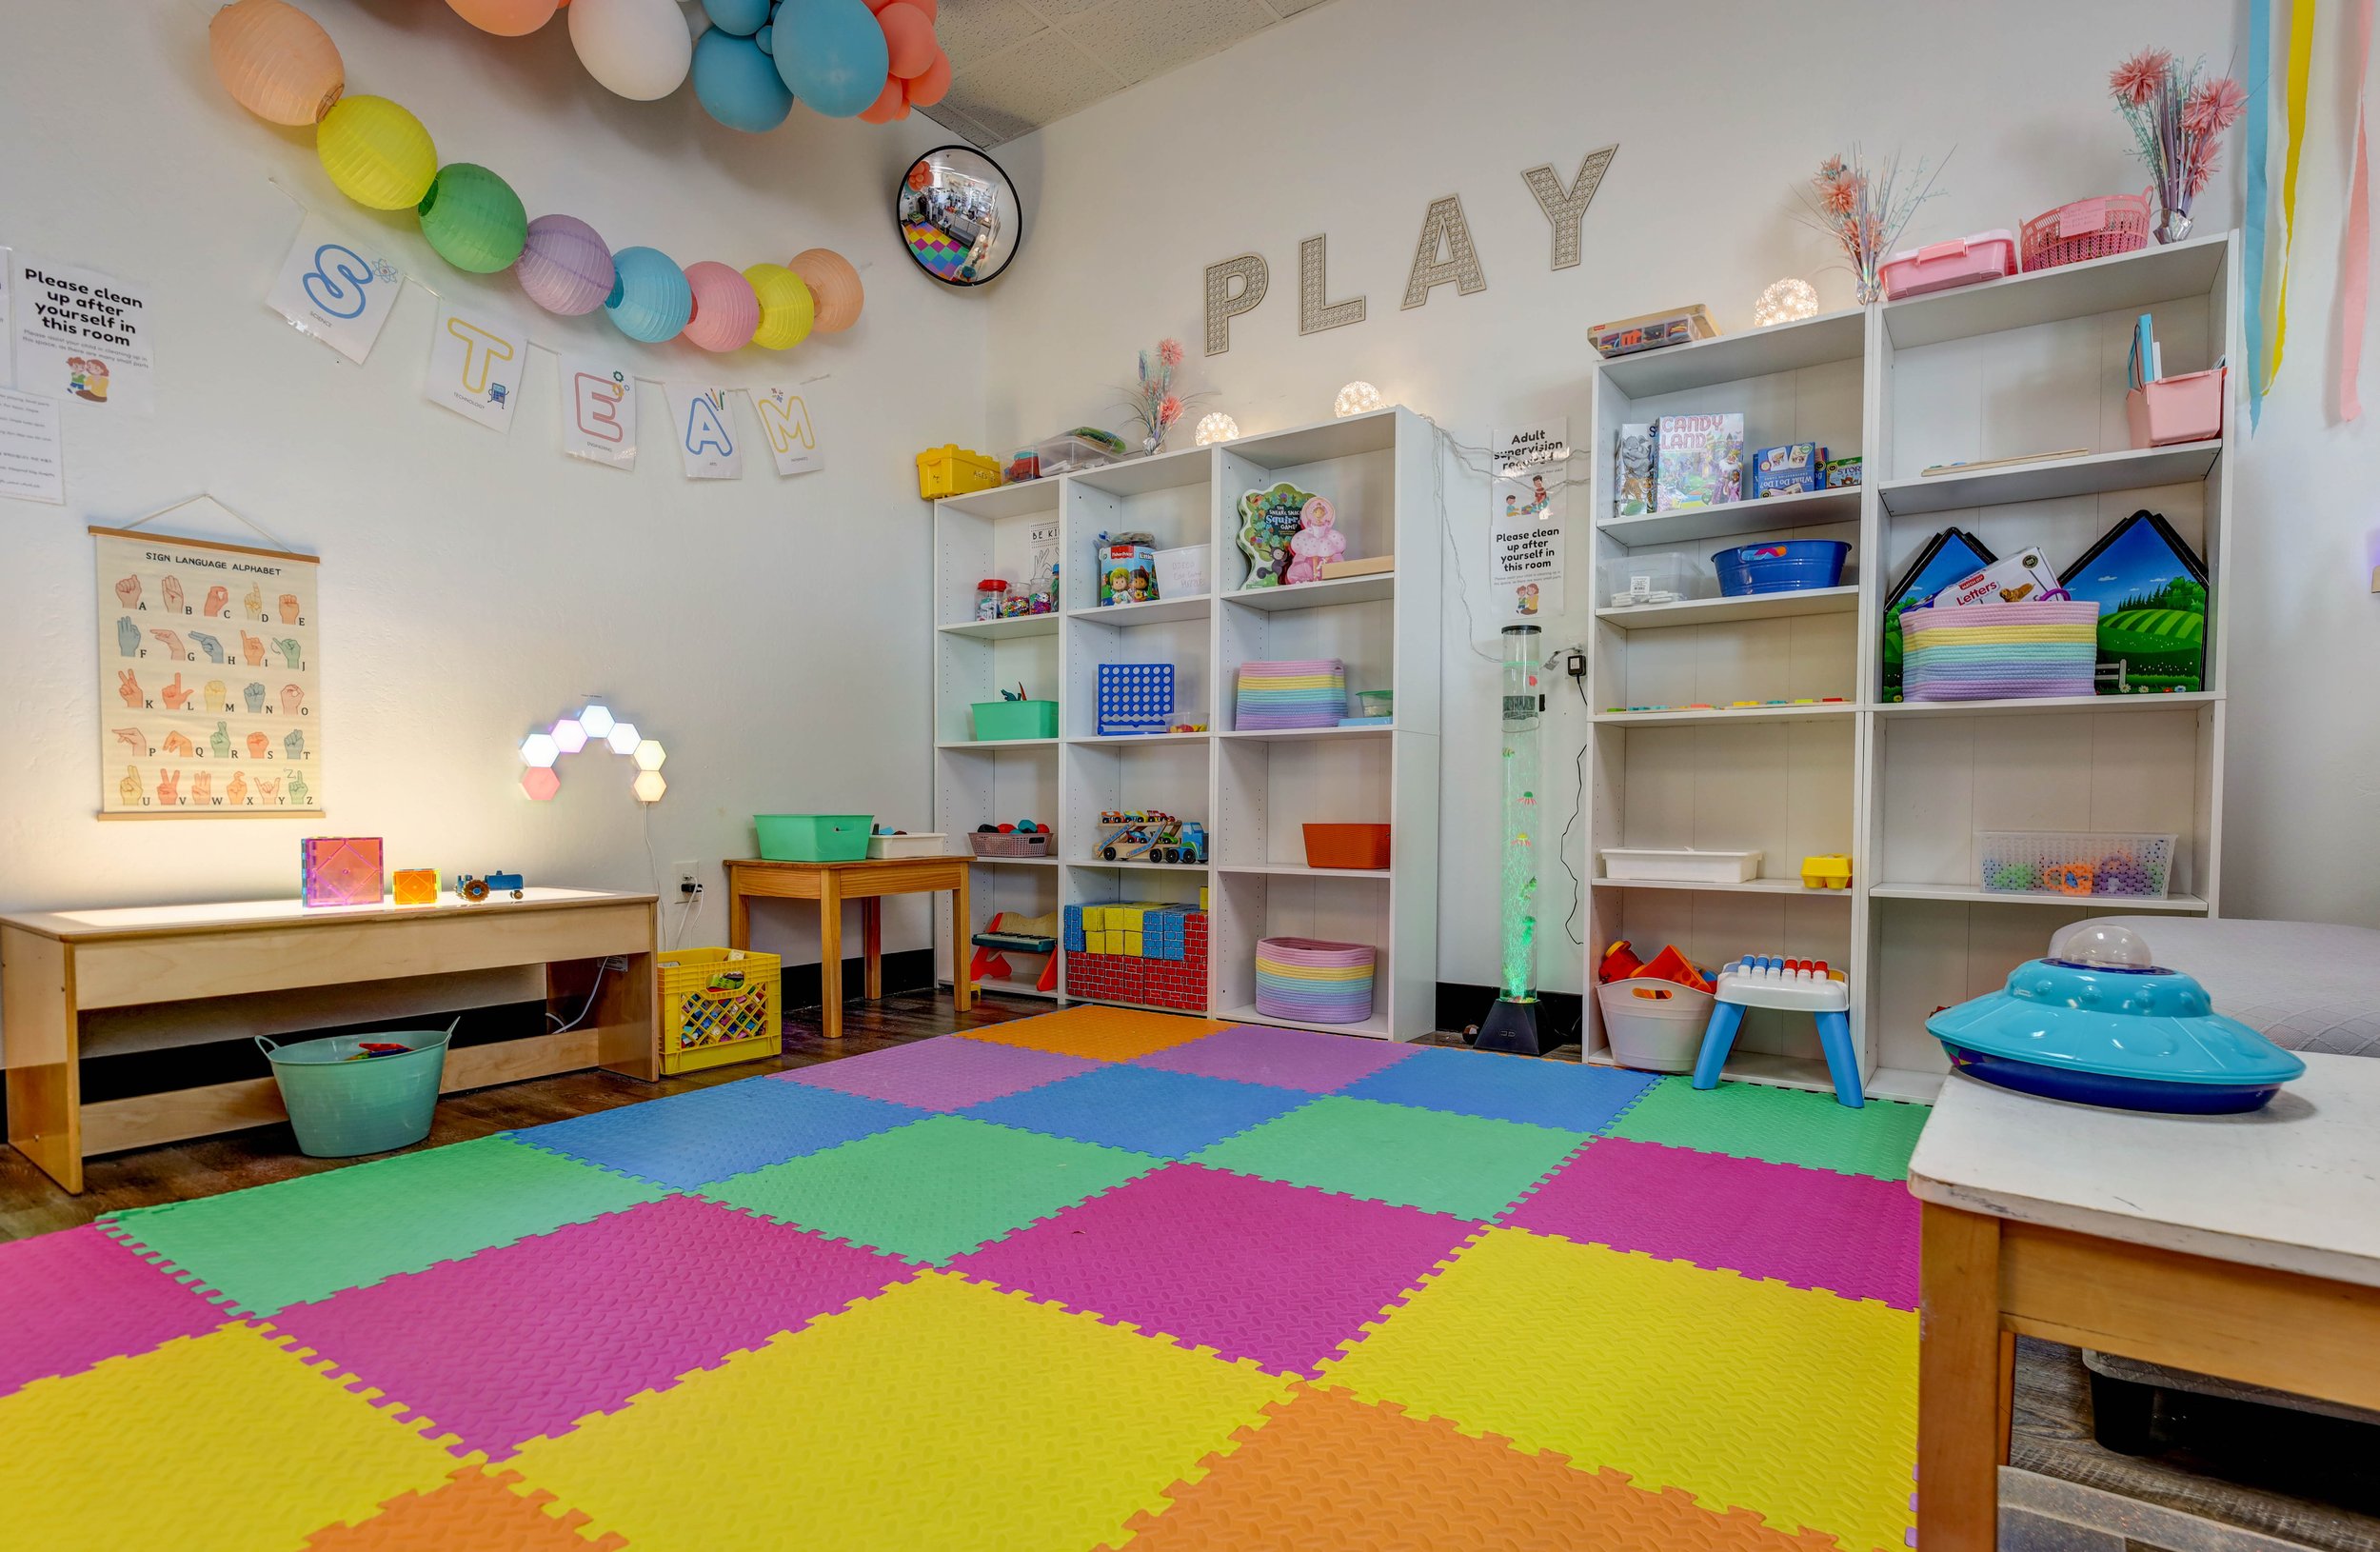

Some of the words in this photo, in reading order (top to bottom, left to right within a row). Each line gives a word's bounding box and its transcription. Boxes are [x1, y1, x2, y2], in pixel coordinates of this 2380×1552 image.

[1203, 143, 1619, 357] PLAY
[25, 268, 89, 294] Please
[94, 288, 143, 308] clean
[302, 243, 374, 319] S
[48, 291, 69, 306] up
[76, 298, 124, 316] after
[34, 302, 115, 328] yourself
[120, 320, 136, 333] in
[42, 316, 77, 334] this
[83, 328, 129, 347] room
[446, 316, 514, 394] T
[574, 371, 624, 443] E
[685, 397, 733, 457] A
[758, 395, 816, 453] M
[1661, 414, 1724, 433] CANDY
[1511, 429, 1545, 445] Adult
[1660, 432, 1707, 450] LAND
[1791, 475, 1814, 487] What
[1048, 528, 1060, 538] KI
[1496, 532, 1529, 543] Please
[1532, 528, 1559, 538] clean
[1500, 548, 1543, 565] yourself
[1546, 548, 1555, 557] in
[1507, 544, 1519, 552] up
[1522, 540, 1548, 549] after
[146, 552, 171, 563] SIGN
[175, 555, 228, 569] LANGUAGE
[232, 563, 282, 576] ALPHABET
[1504, 562, 1522, 571] this
[1525, 560, 1552, 569] room
[1956, 581, 1997, 607] Letters
[139, 602, 147, 610] A
[185, 607, 192, 615] B
[224, 610, 230, 619] C
[261, 614, 269, 623] D
[140, 649, 147, 659] F
[188, 652, 195, 662] G
[228, 656, 236, 665] H
[302, 663, 306, 671] J
[145, 700, 153, 708] K
[225, 704, 235, 712] M
[266, 706, 273, 714] N
[301, 707, 308, 716] O
[149, 747, 156, 756] P
[195, 747, 204, 758] Q
[231, 750, 238, 759] R
[304, 751, 310, 760] T
[143, 797, 150, 806] U
[211, 797, 223, 806] W
